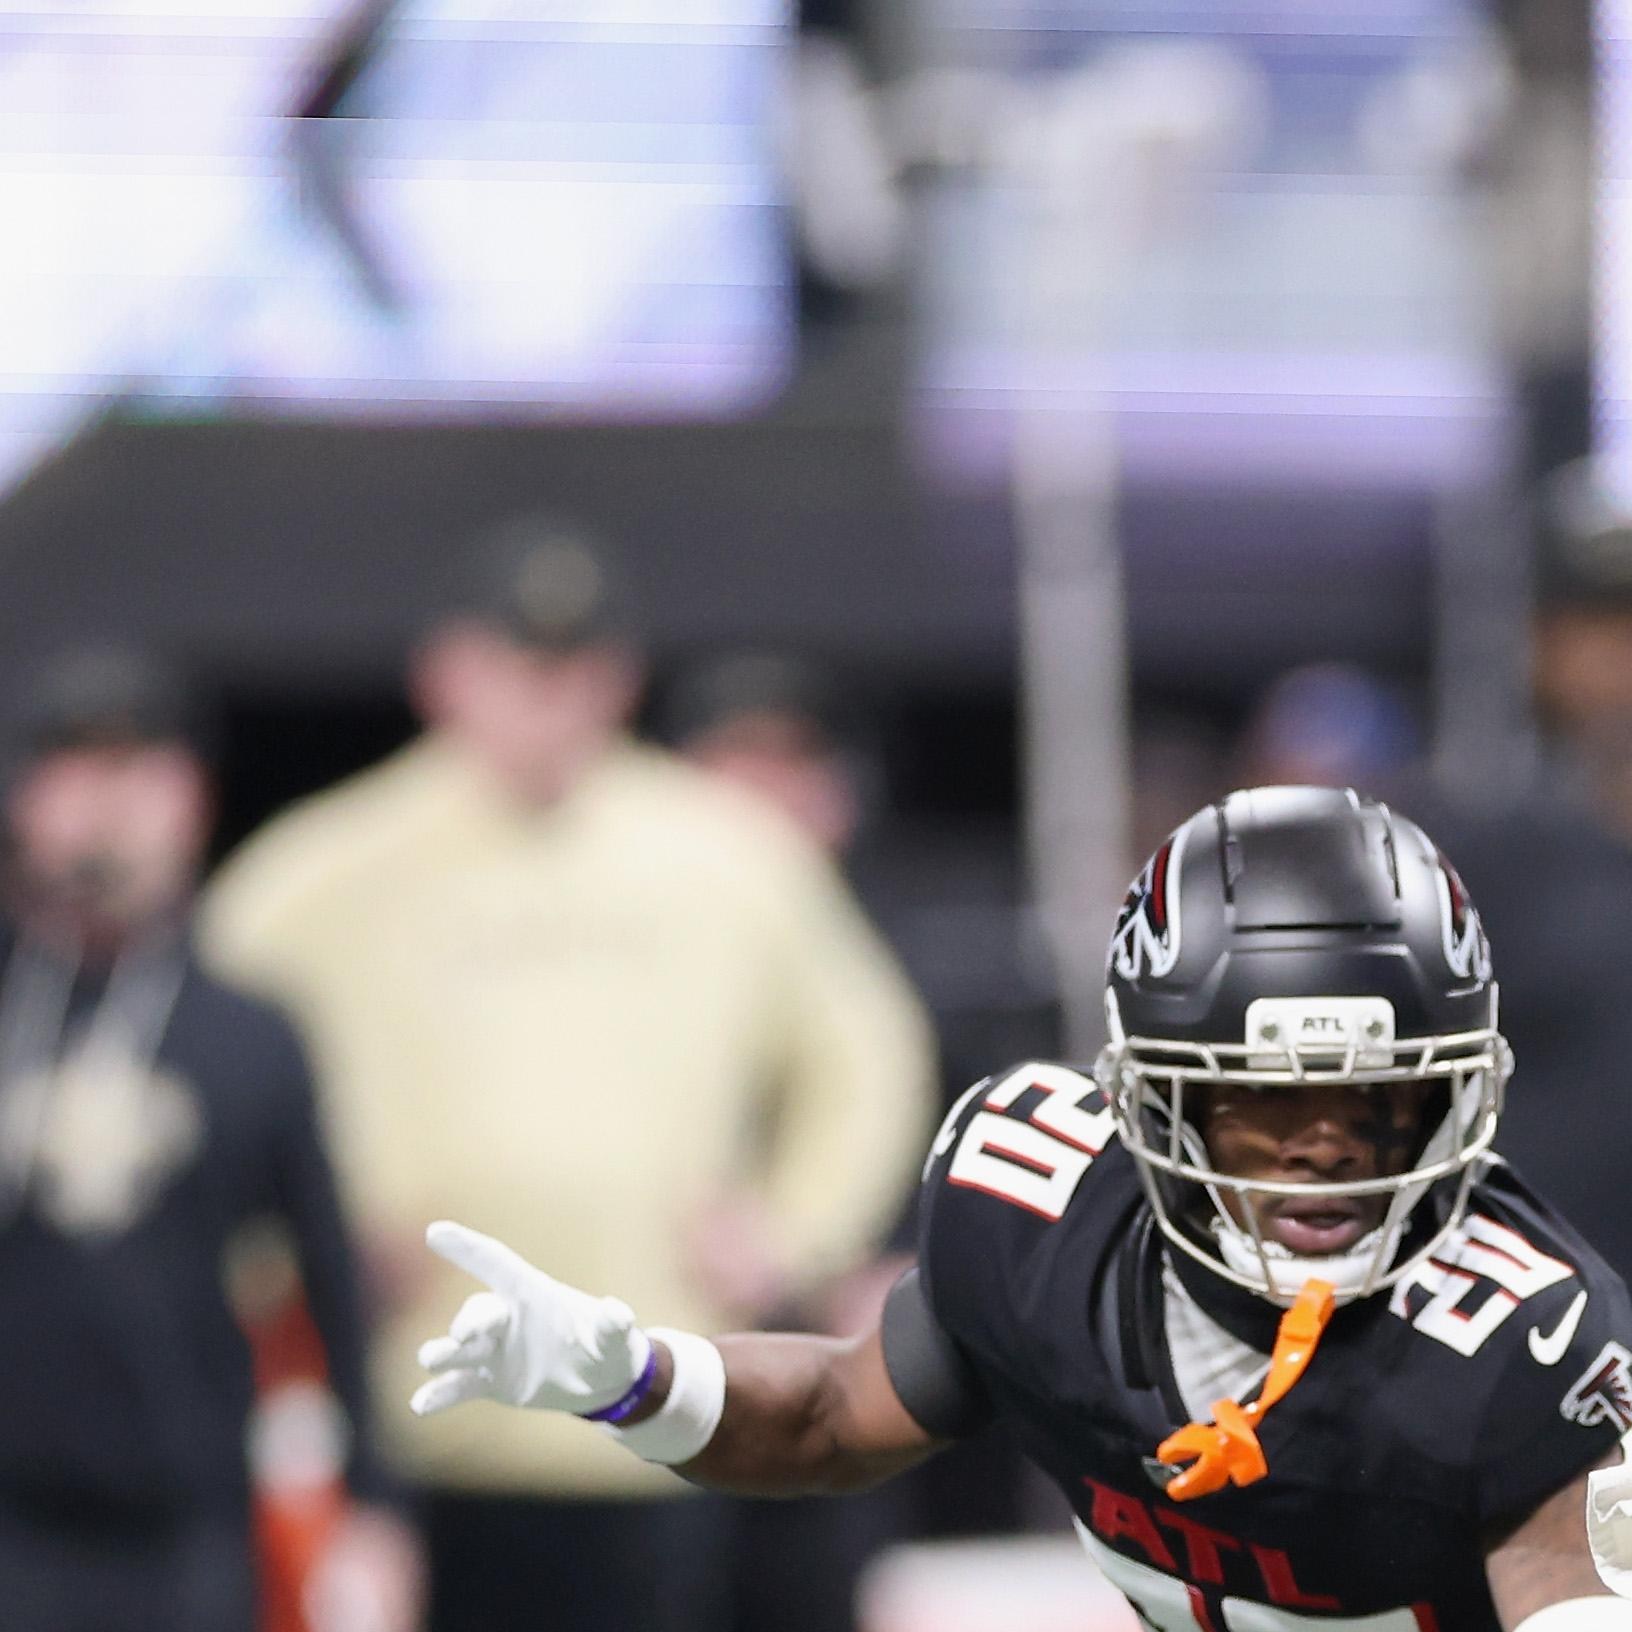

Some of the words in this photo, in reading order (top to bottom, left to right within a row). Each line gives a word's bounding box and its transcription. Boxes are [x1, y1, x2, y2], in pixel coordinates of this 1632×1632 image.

[1302, 1016, 1344, 1033] ATL
[1388, 1212, 1578, 1358] 20
[1083, 1476, 1342, 1610] ATL
